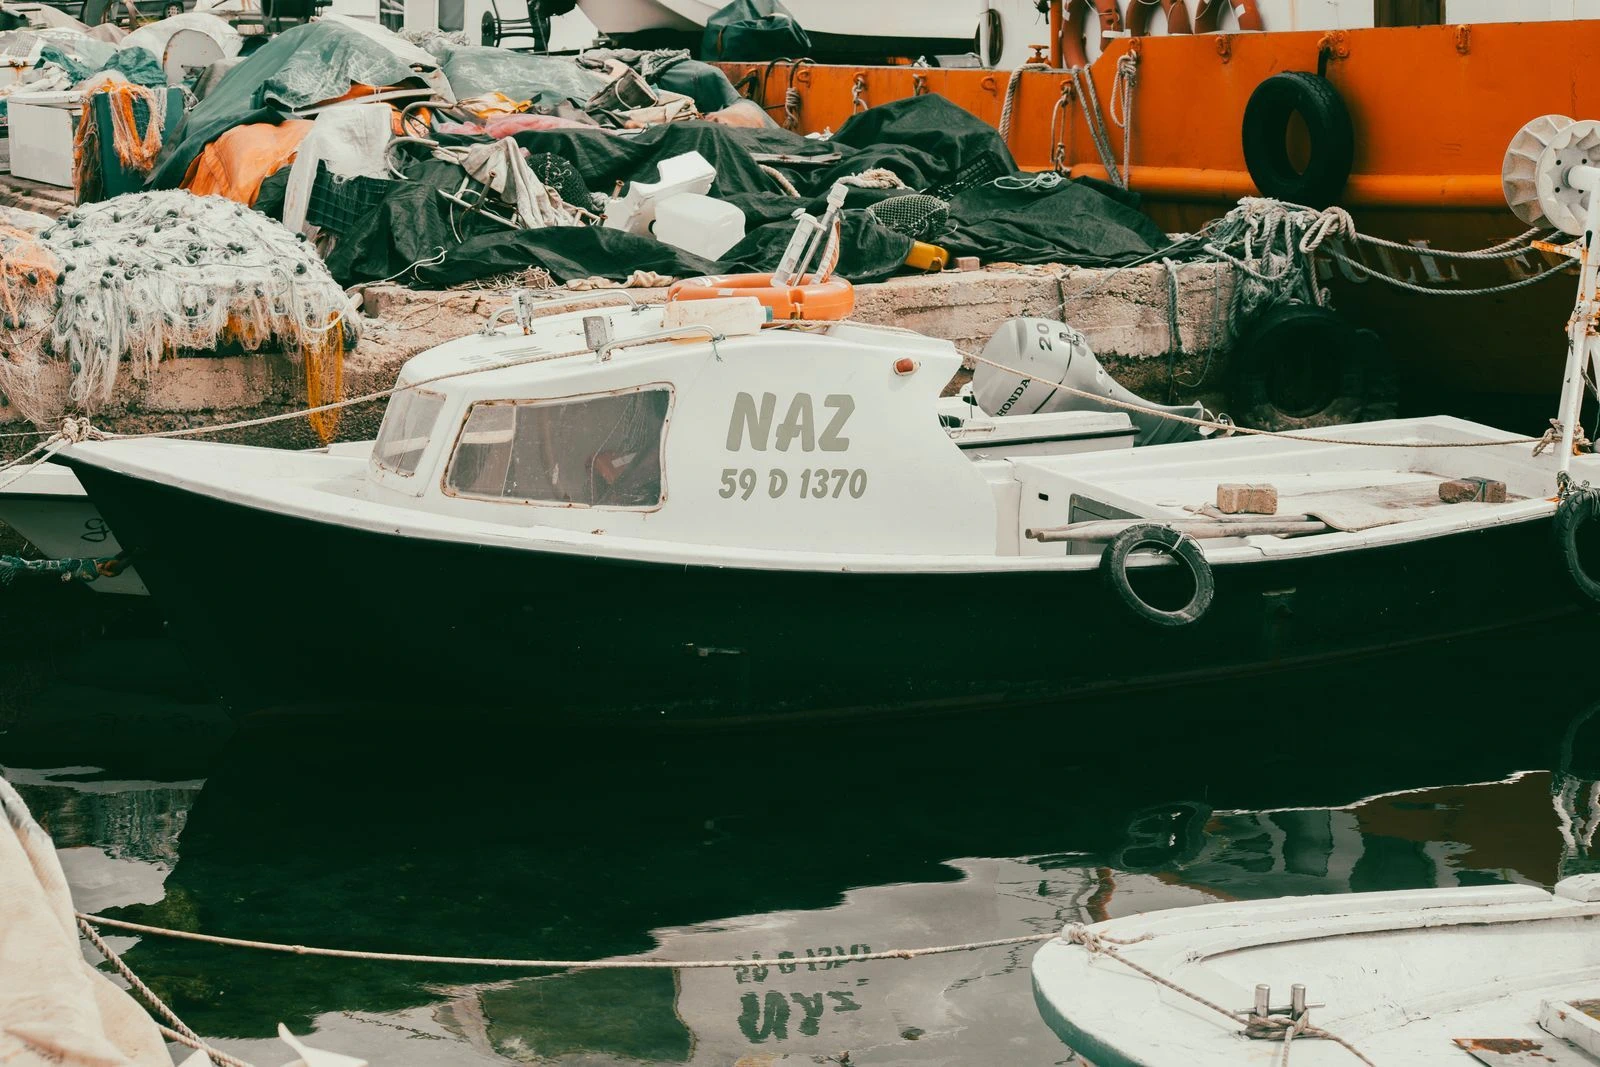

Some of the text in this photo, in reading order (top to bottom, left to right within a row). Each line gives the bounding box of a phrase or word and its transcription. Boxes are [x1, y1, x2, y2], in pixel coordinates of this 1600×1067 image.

[1037, 323, 1052, 352] 20
[997, 379, 1031, 416] HONDA
[726, 392, 855, 452] NAZ
[718, 468, 868, 501] 59 D 1370
